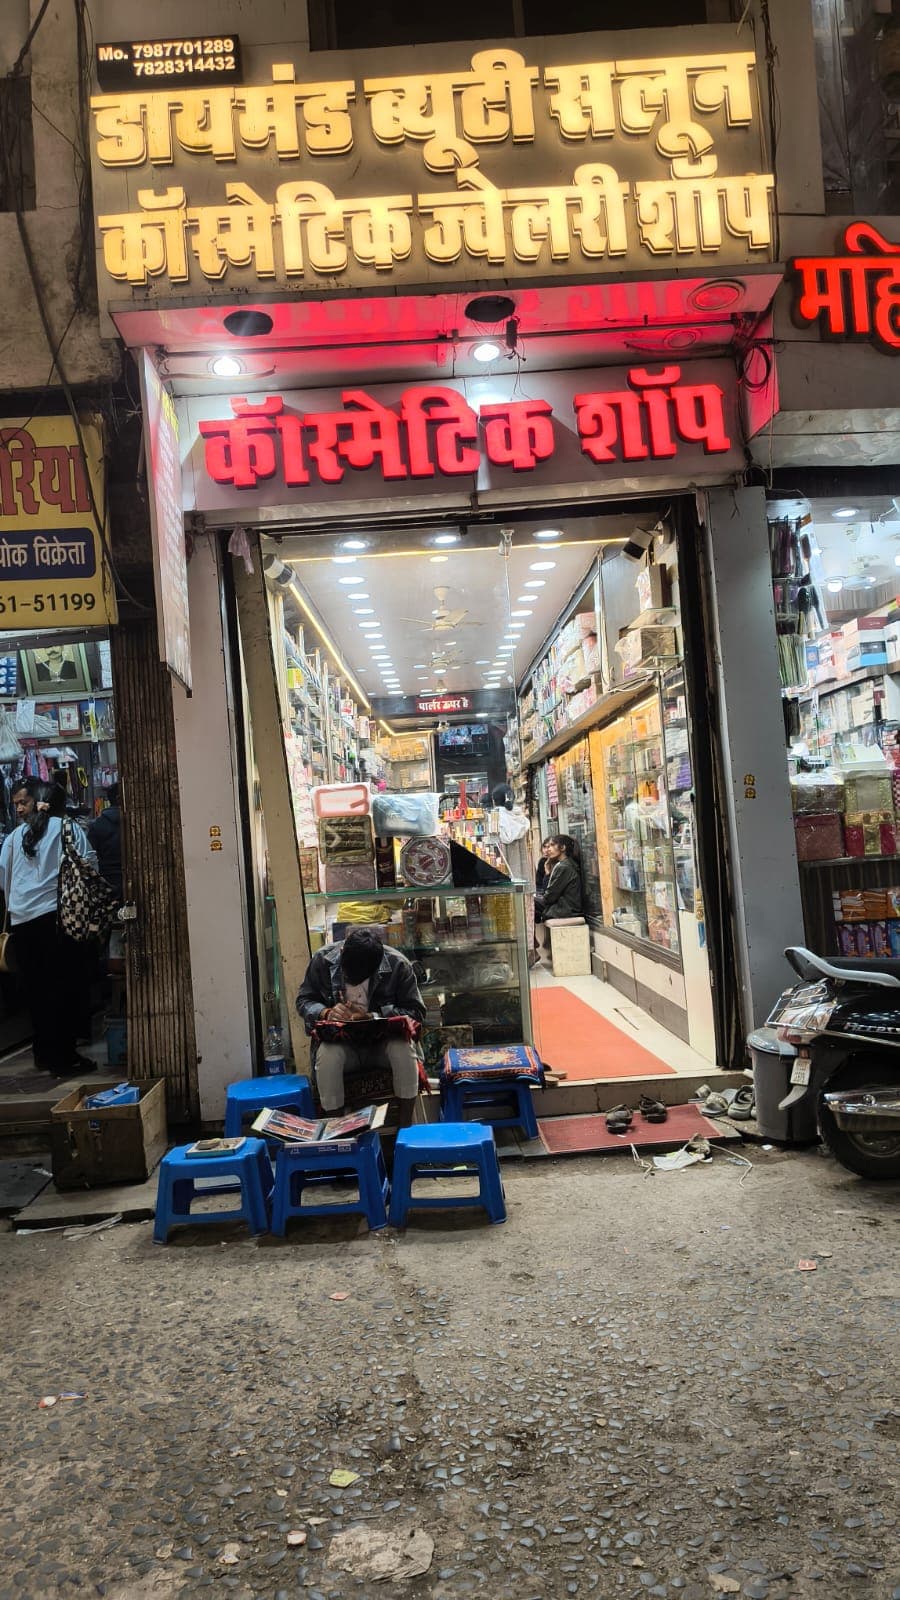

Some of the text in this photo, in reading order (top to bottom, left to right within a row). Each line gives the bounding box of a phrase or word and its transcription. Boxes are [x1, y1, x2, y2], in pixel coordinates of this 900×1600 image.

[99, 39, 234, 61] Mo. 7987701289
[133, 56, 236, 76] 7828314432
[90, 49, 756, 173] डायमंड ब्यूटी सलून
[98, 154, 775, 285] कॉस्मेटिक ज्वेलरी शॉप
[198, 365, 731, 489] कॉस्मेटिक शॉप
[33, 536, 86, 567] विक्रेता
